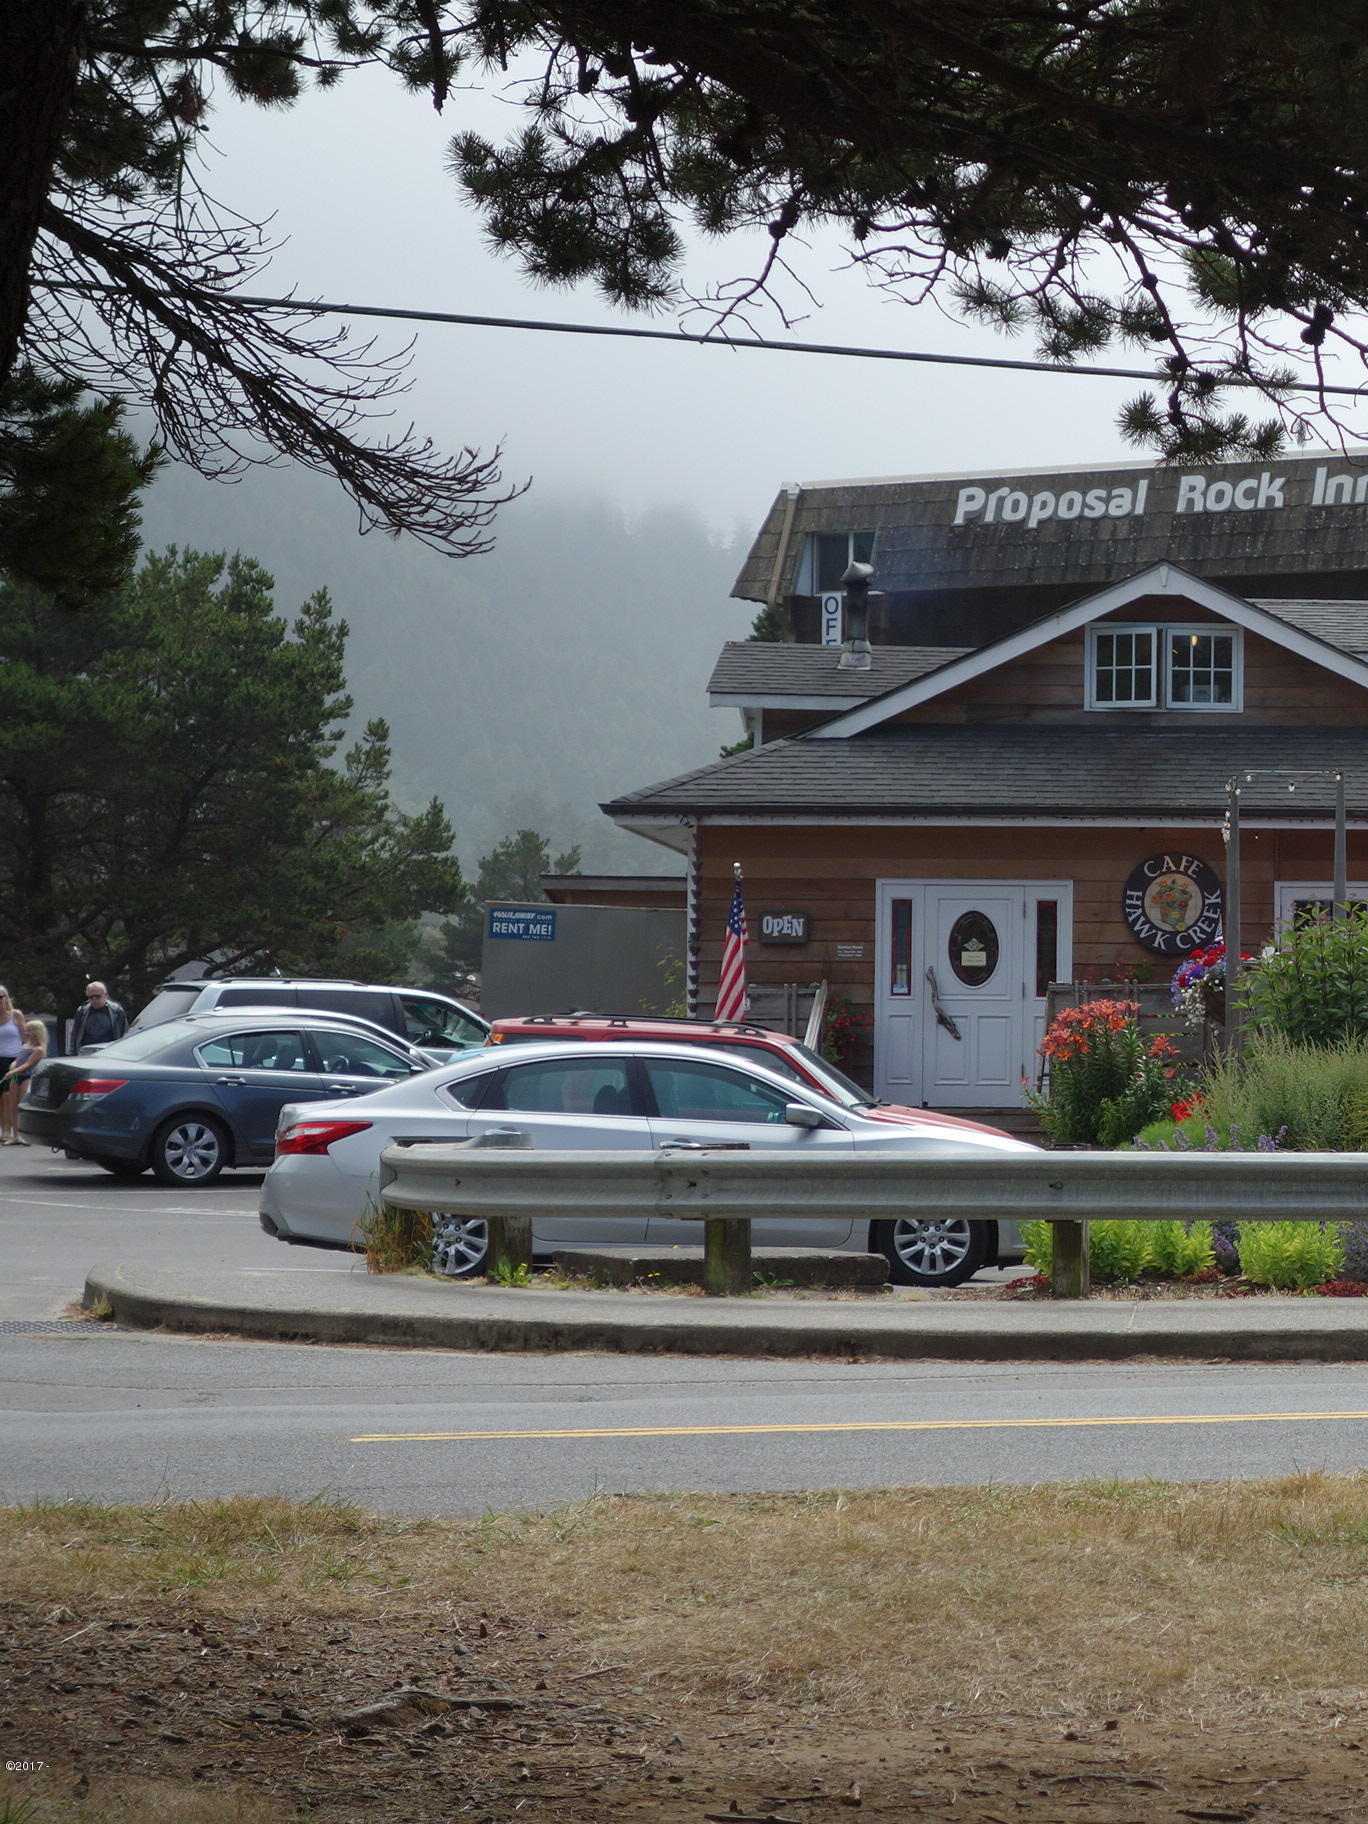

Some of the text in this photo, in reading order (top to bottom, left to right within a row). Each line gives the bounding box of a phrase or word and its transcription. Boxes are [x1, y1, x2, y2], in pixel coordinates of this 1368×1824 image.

[952, 478, 1148, 529] Proposal
[1175, 471, 1289, 514] Rock
[824, 596, 839, 645] OF
[1144, 855, 1204, 878] CAFE
[493, 922, 552, 935] RENT ME!
[762, 915, 805, 937] OPEN
[1125, 888, 1222, 950] HAWK CREEK
